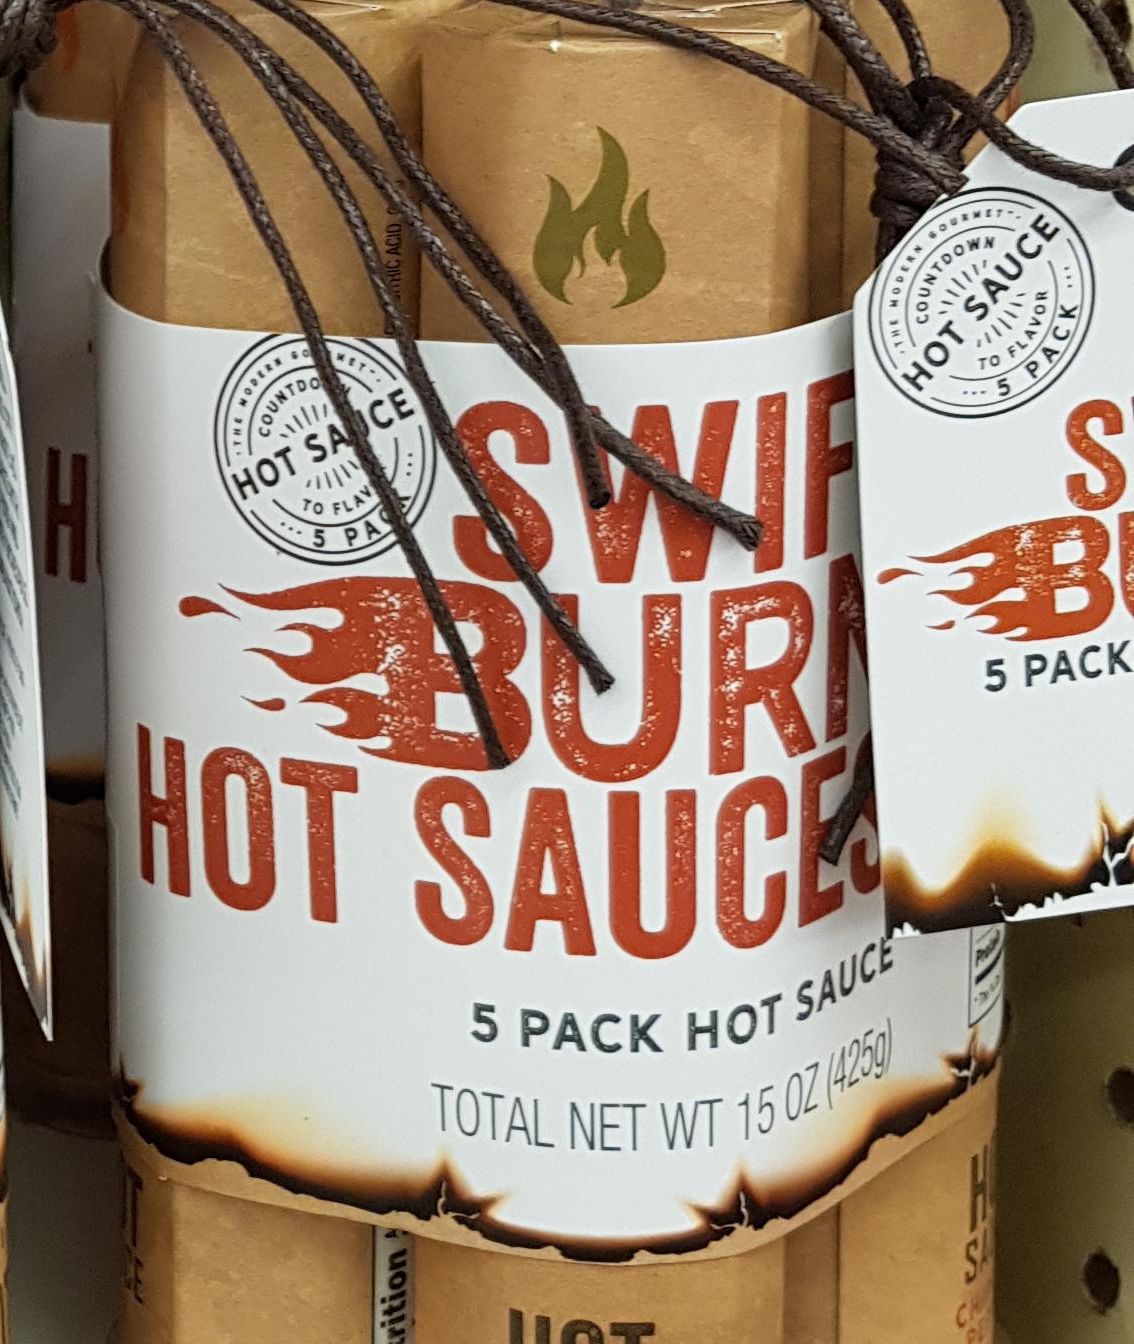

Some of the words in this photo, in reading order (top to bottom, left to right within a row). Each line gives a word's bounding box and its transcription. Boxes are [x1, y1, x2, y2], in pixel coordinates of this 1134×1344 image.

[900, 319, 965, 392] HOT
[963, 213, 1061, 322] SAUCE
[916, 236, 996, 325] COUNTDOWN
[978, 354, 1001, 370] TO
[1007, 290, 1048, 359] FLAVOR
[996, 377, 1012, 397] 5
[1024, 303, 1080, 380] PACK
[258, 376, 352, 438] COUNTDO
[232, 445, 297, 501] HOT
[302, 498, 324, 516] TO
[451, 366, 855, 584] SWIF
[312, 528, 326, 548] 5
[984, 658, 1007, 693] 5
[1023, 639, 1134, 688] PACK
[137, 722, 359, 924] HOT
[470, 1002, 499, 1044] 5
[519, 1007, 664, 1054] PACK
[686, 992, 783, 1052] HOT
[795, 935, 895, 1022] SAUCE
[430, 1081, 556, 1149] TOTAL
[569, 1101, 647, 1152] NET
[659, 1097, 724, 1151] WT
[737, 1085, 775, 1140] 15
[784, 1062, 820, 1122] OZ
[826, 1016, 893, 1111] (425g)
